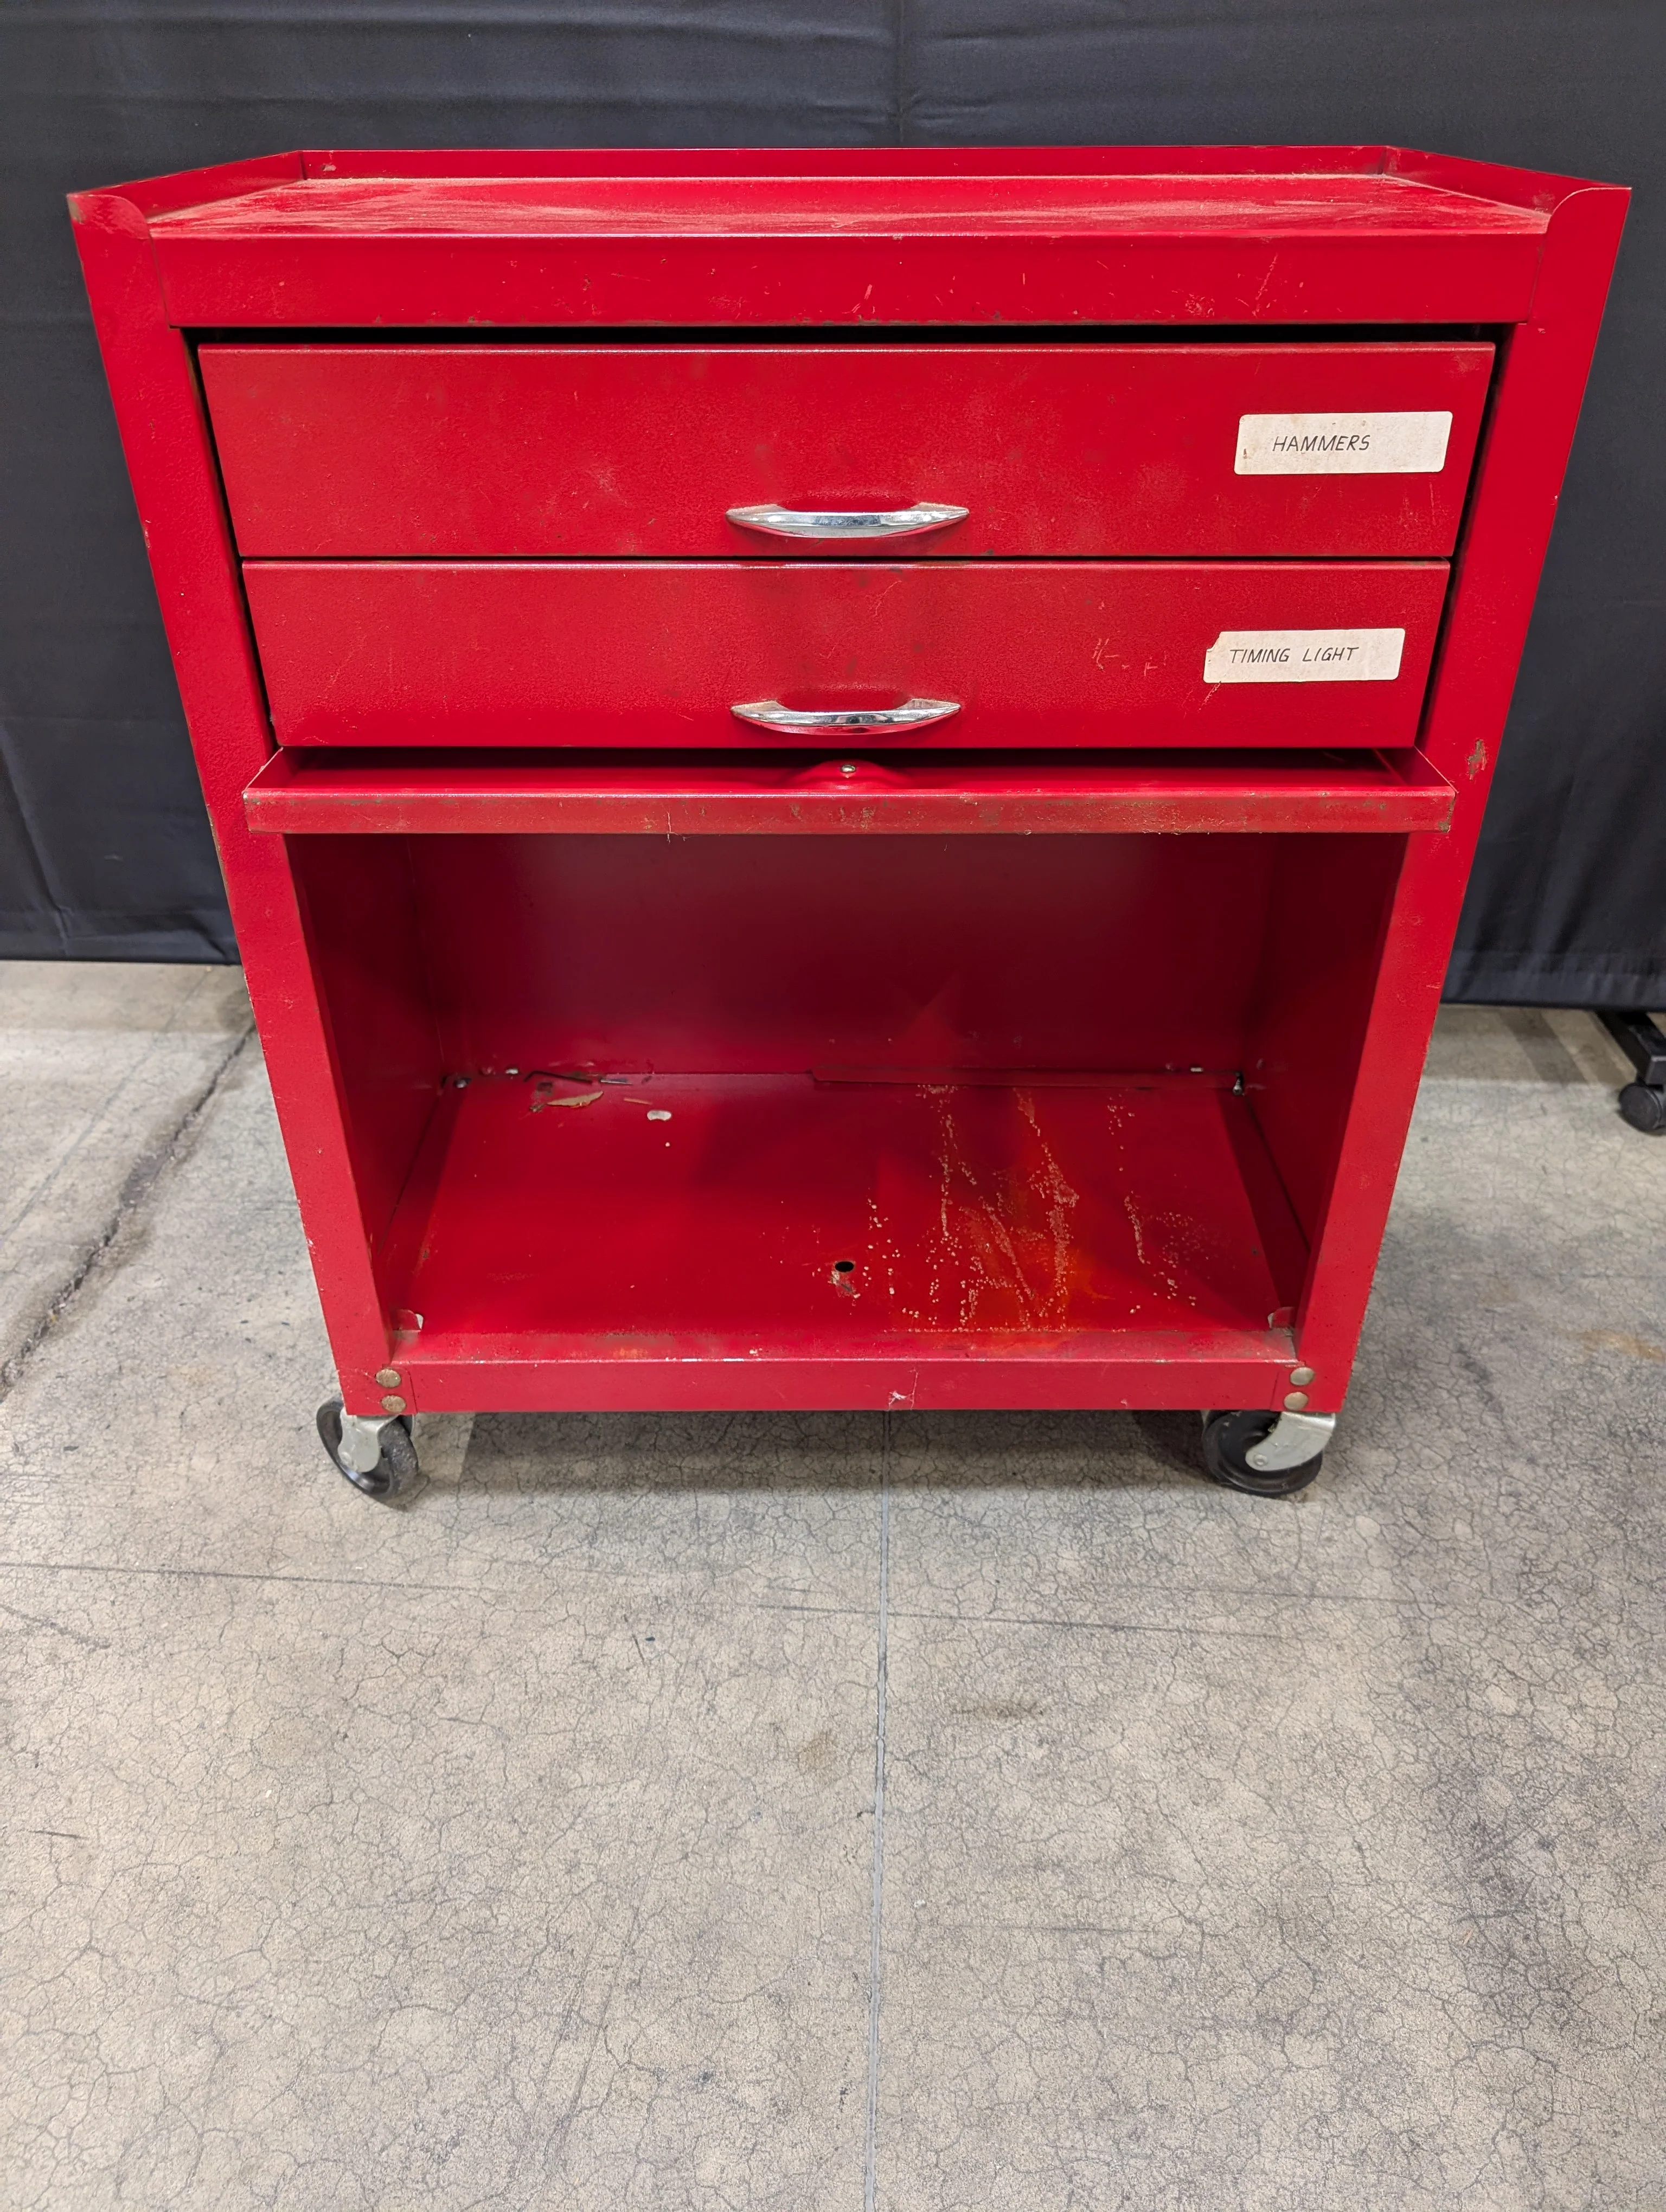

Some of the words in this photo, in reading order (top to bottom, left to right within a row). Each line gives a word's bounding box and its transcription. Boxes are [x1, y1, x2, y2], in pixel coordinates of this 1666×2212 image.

[1272, 434, 1371, 452] HAMMERS
[1229, 648, 1291, 664] TIMING
[1302, 646, 1360, 662] LIGHT
